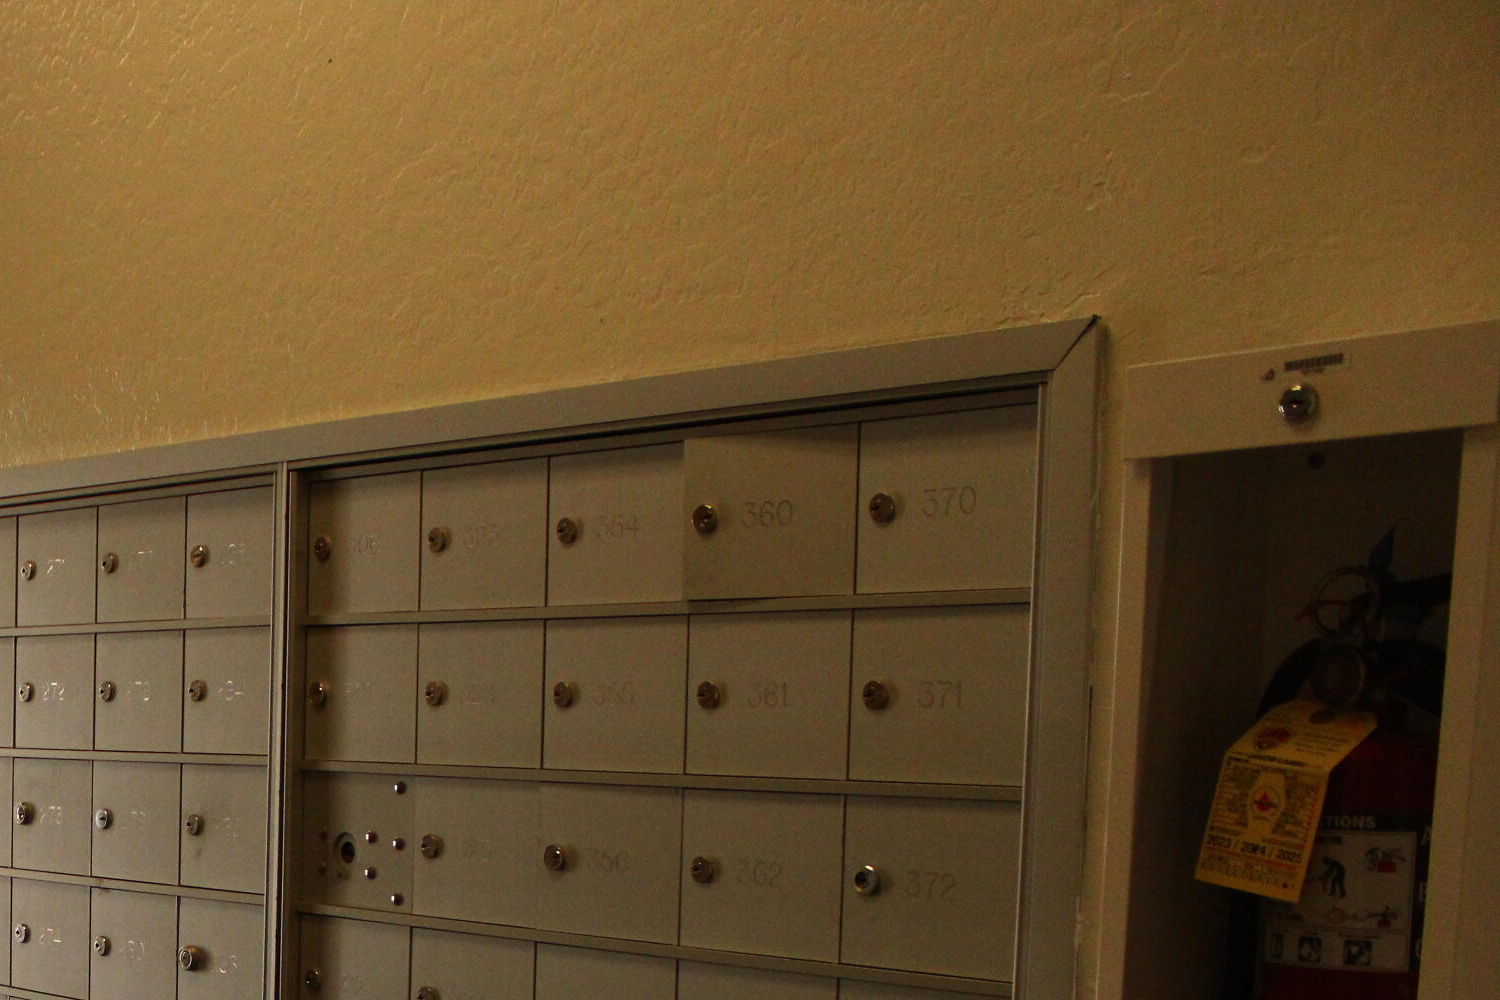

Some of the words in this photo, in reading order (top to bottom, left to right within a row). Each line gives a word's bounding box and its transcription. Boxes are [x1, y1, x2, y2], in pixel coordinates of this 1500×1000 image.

[742, 500, 793, 529] 360
[922, 486, 976, 517] 370
[748, 681, 787, 708] 361
[918, 681, 962, 709] 371
[1320, 815, 1377, 829] TIONS
[1206, 834, 1231, 849] 2023
[1276, 848, 1303, 863] 2025
[737, 858, 783, 888] 362
[906, 870, 956, 900] 372
